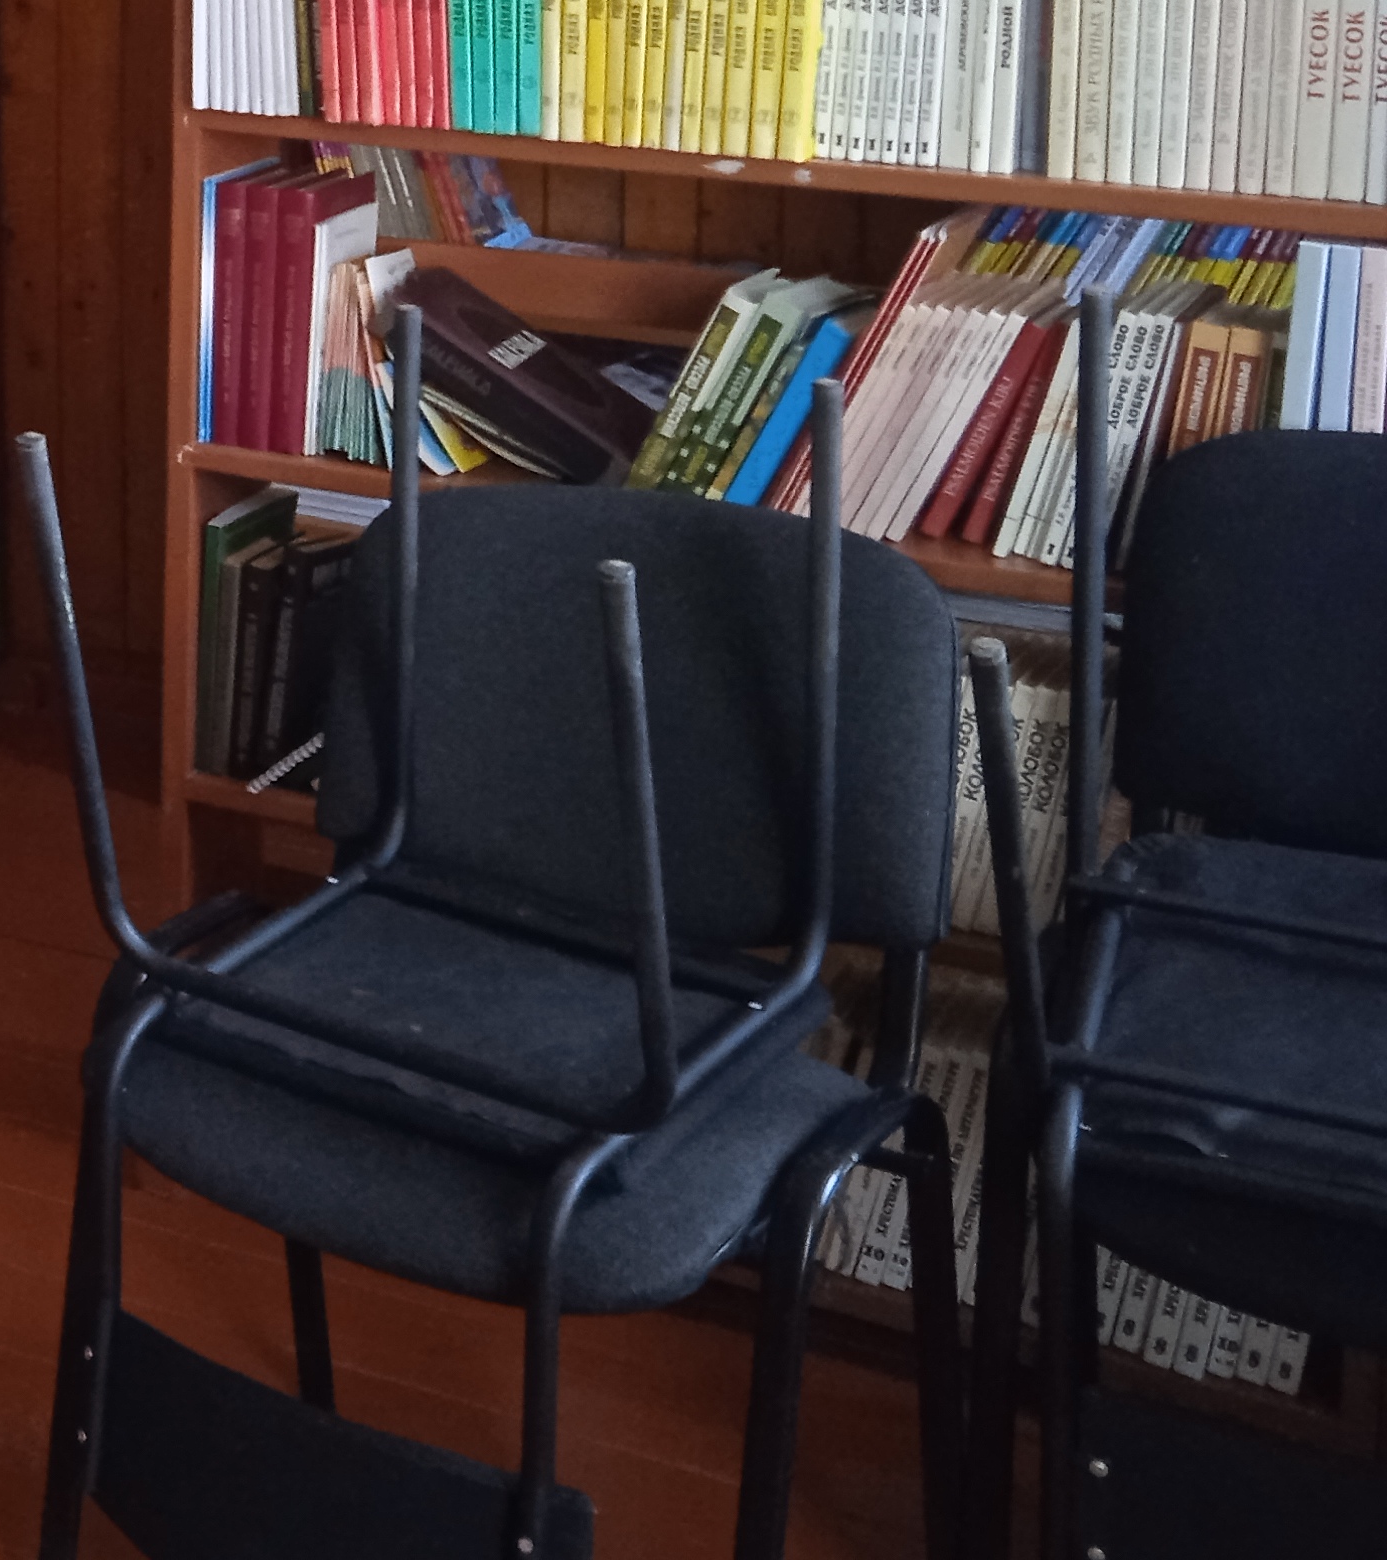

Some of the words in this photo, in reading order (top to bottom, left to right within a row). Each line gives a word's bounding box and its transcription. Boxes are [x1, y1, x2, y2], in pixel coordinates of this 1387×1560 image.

[1000, 6, 1014, 69] РОДНОЙ
[1306, 8, 1331, 100] ТУЕСОК
[1341, 10, 1366, 102] ТУЕСОК
[1125, 326, 1148, 372] СЛОВО
[1126, 374, 1152, 429] ДОБРОЕ
[1143, 324, 1165, 371] СЛОВО
[1033, 721, 1070, 814] КОЛОБОК
